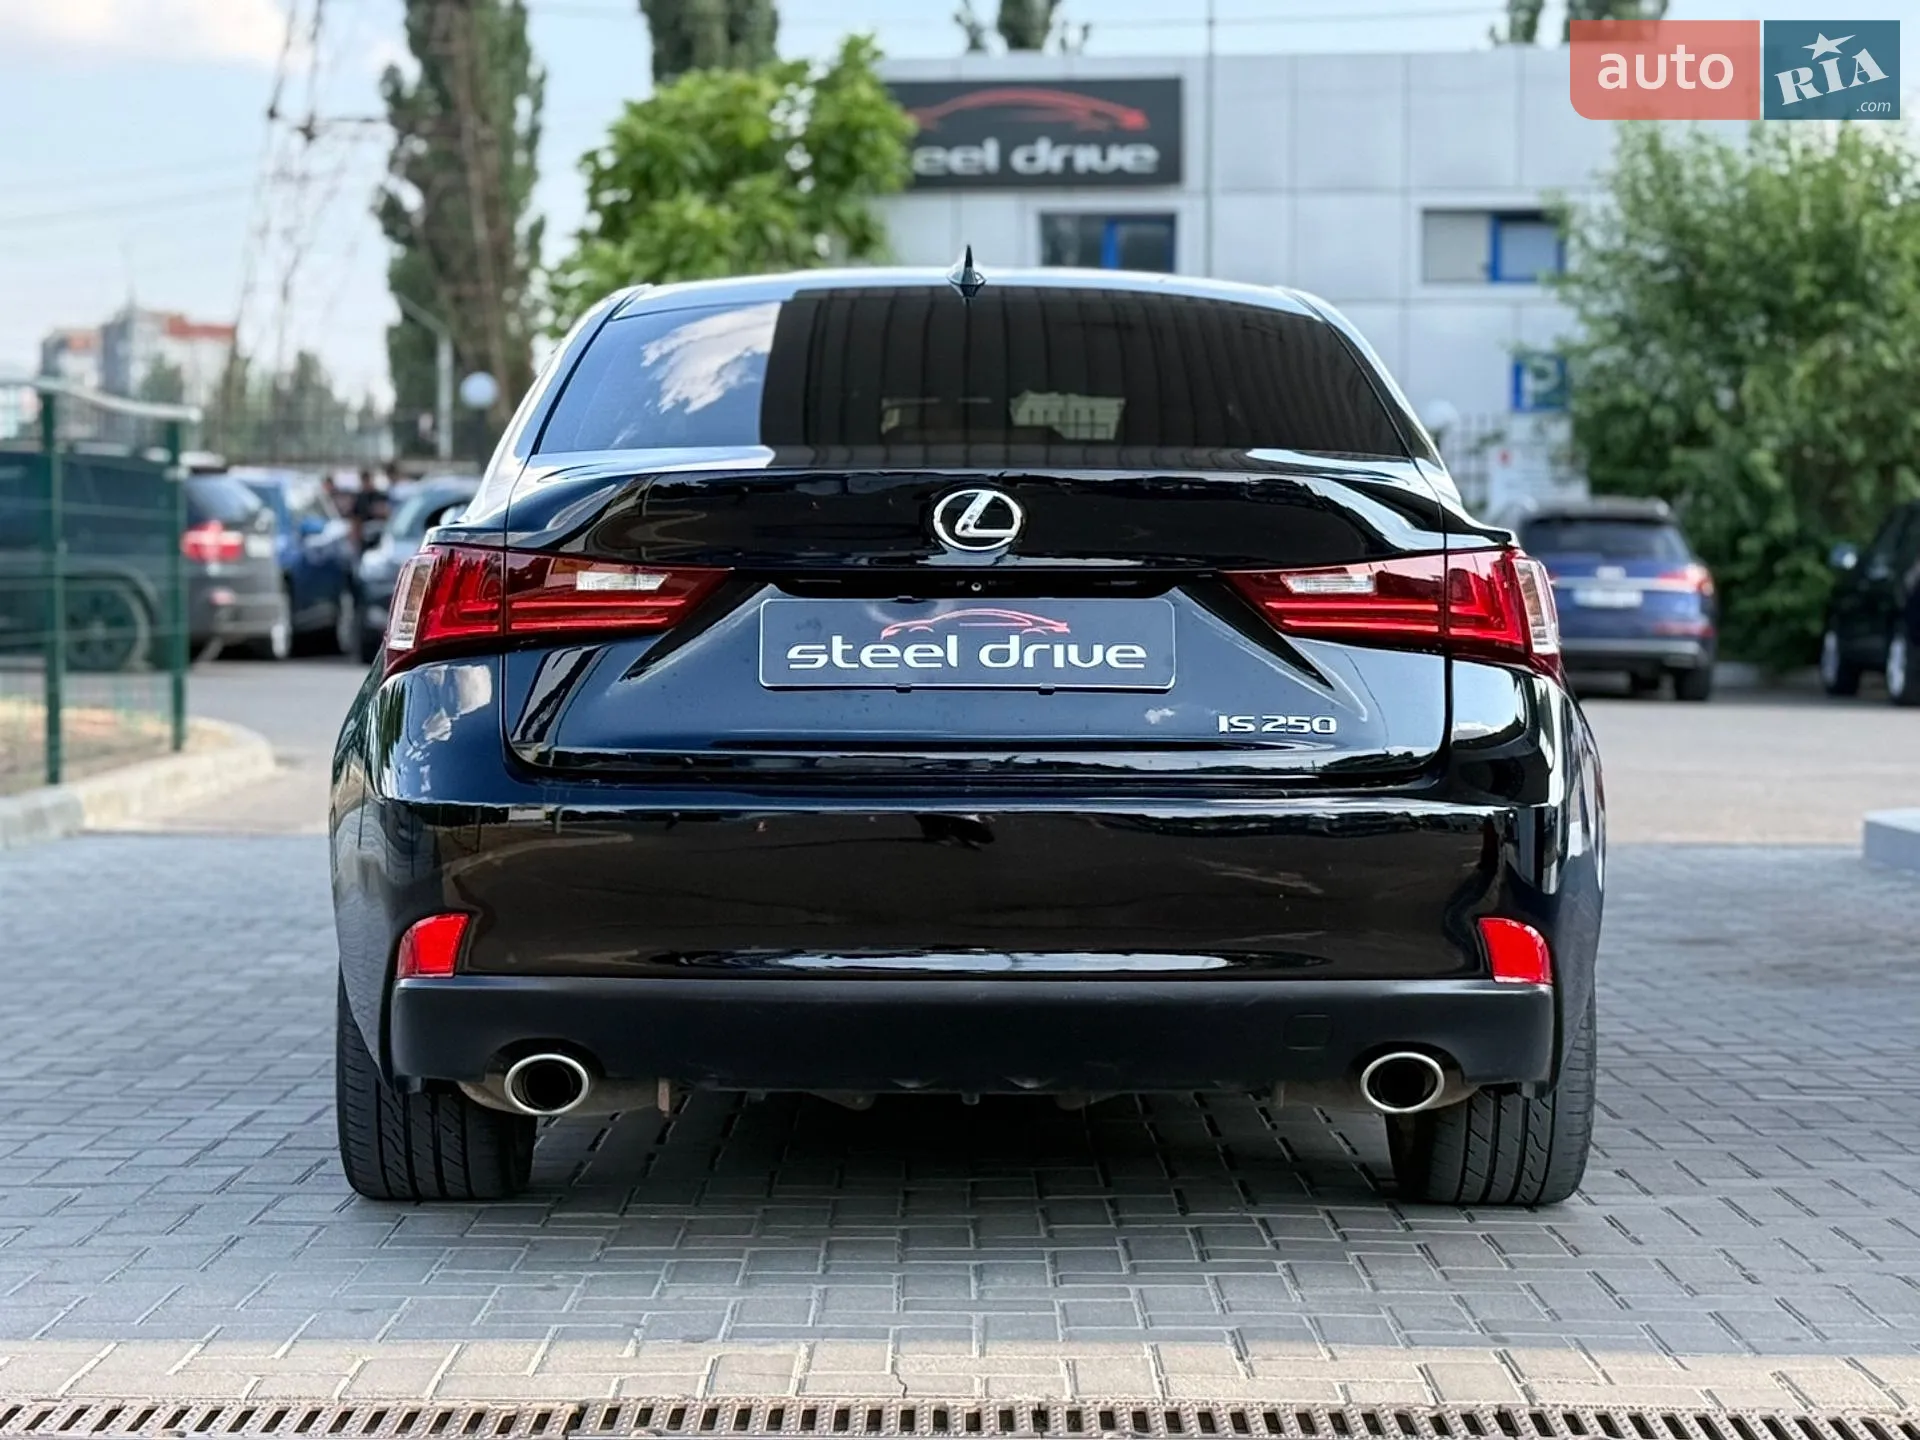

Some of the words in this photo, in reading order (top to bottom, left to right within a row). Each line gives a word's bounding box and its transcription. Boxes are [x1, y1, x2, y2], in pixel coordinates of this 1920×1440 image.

[912, 136, 999, 176] eel
[1009, 136, 1160, 176] drive
[787, 635, 958, 669] steel
[978, 635, 1147, 669] drive
[1218, 715, 1256, 733] IS
[1261, 715, 1337, 734] 250
